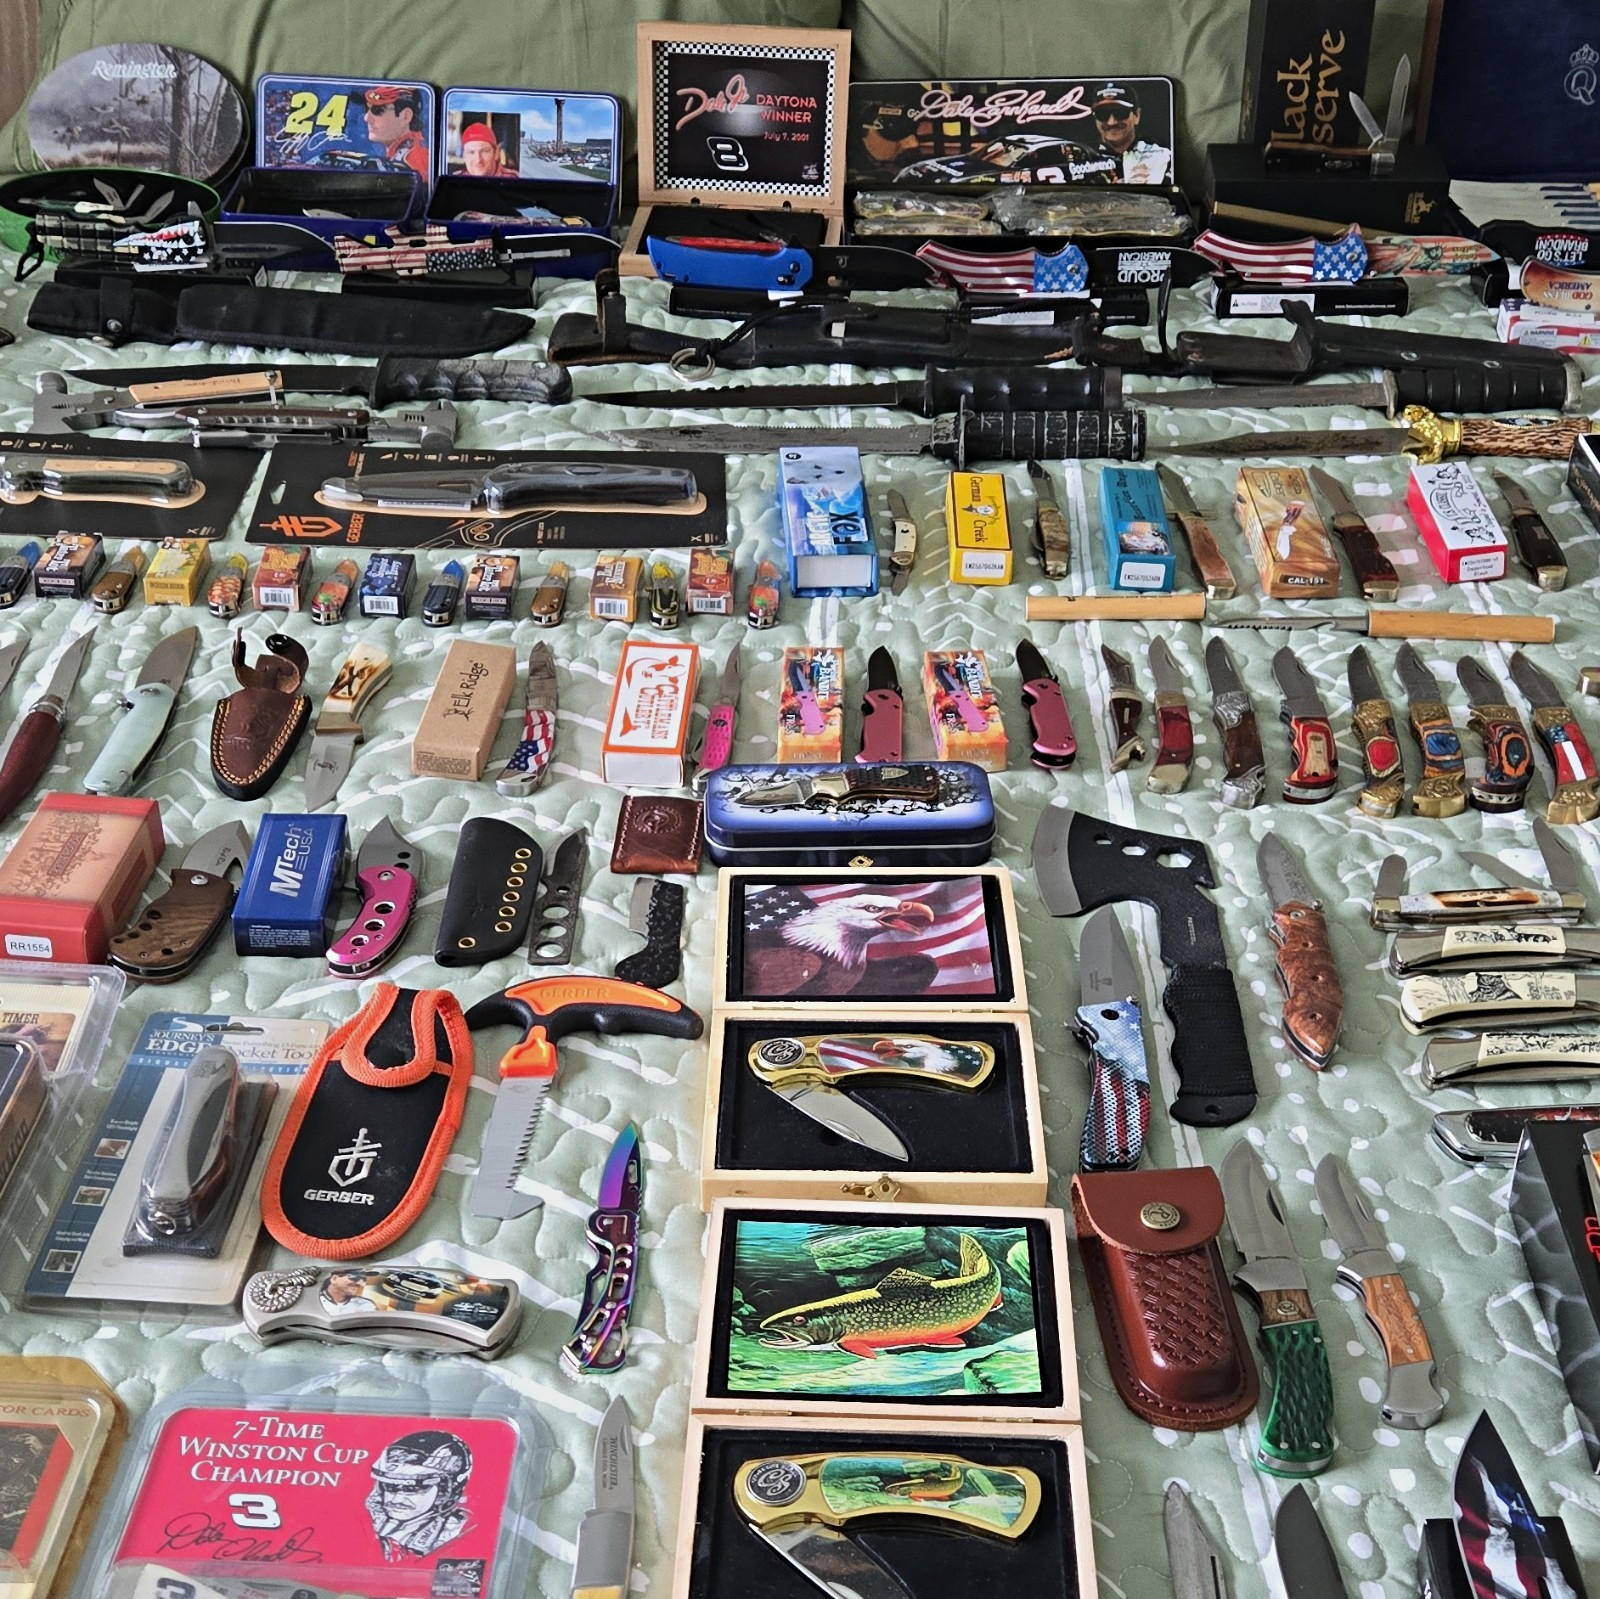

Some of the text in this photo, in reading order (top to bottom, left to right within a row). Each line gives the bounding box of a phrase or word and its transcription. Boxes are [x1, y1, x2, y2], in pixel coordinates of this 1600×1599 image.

[756, 94, 818, 109] DAYTONA
[1271, 53, 1313, 143] lack
[288, 92, 348, 134] 24
[760, 111, 813, 123] WINNER
[791, 132, 810, 142] 2001
[706, 136, 750, 172] 8
[1535, 238, 1589, 251] BRANDON!
[1120, 252, 1171, 265] AMERICAN
[1537, 249, 1584, 261] LET'S GO
[1548, 281, 1593, 293] AMERICA
[1571, 290, 1594, 300] GOD
[969, 476, 986, 543] German Creek
[346, 512, 366, 545] GERBER
[451, 660, 489, 709] Elk Ridge
[300, 827, 315, 857] USA
[9, 940, 51, 953] RR1554
[2, 1012, 39, 1025] TIMER
[237, 1045, 276, 1058] ocket
[303, 1189, 375, 1206] GERBER
[0, 1405, 91, 1418] OR CARDS
[232, 1416, 324, 1440] 7-TIME
[179, 1436, 369, 1466] WINSTON CUP
[190, 1461, 341, 1487] CHAMPION
[228, 1493, 281, 1529] 3
